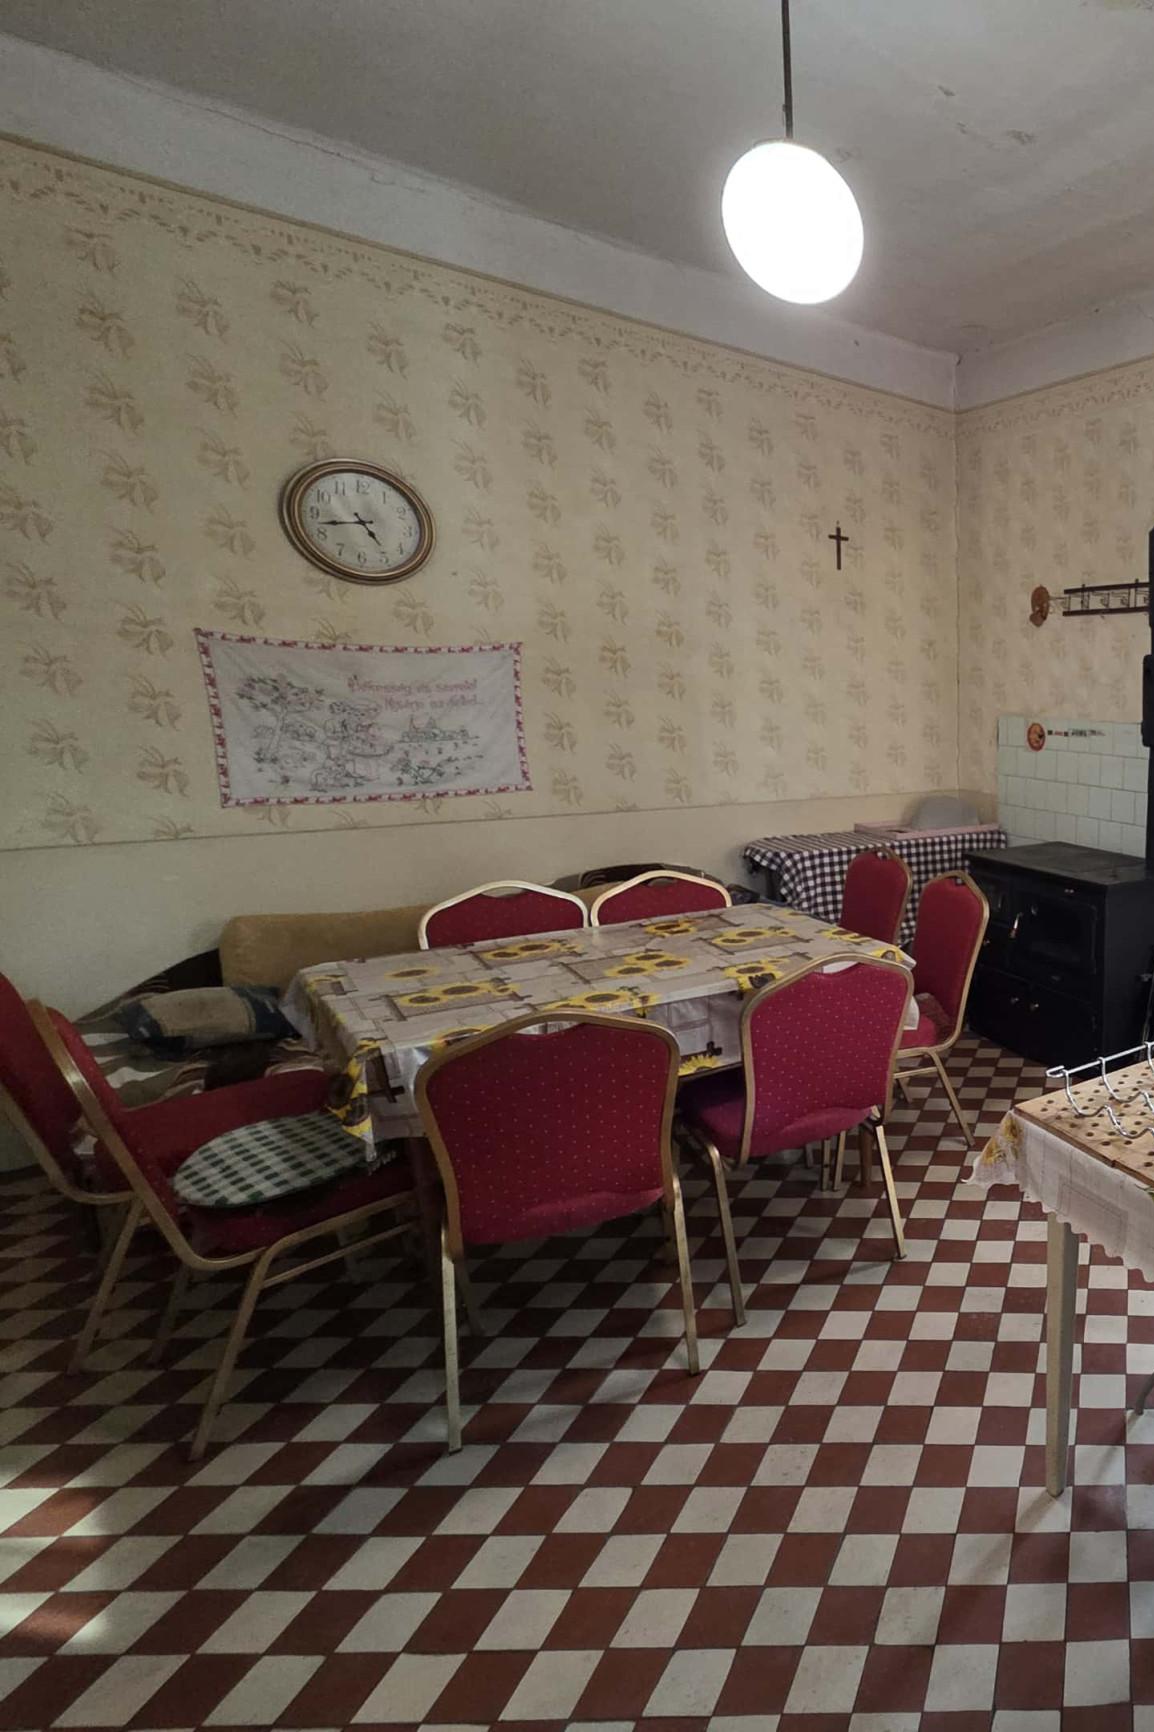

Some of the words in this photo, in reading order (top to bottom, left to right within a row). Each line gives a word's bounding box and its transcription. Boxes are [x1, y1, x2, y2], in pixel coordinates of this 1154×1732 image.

[334, 480, 347, 496] 11
[355, 479, 371, 495] 12
[316, 489, 331, 504] 10
[309, 506, 320, 520] 9
[396, 506, 407, 520] 2
[316, 527, 328, 541] 8
[403, 526, 413, 538] 3
[336, 542, 345, 557] 7
[357, 551, 367, 564] 6
[379, 551, 390, 564] 5
